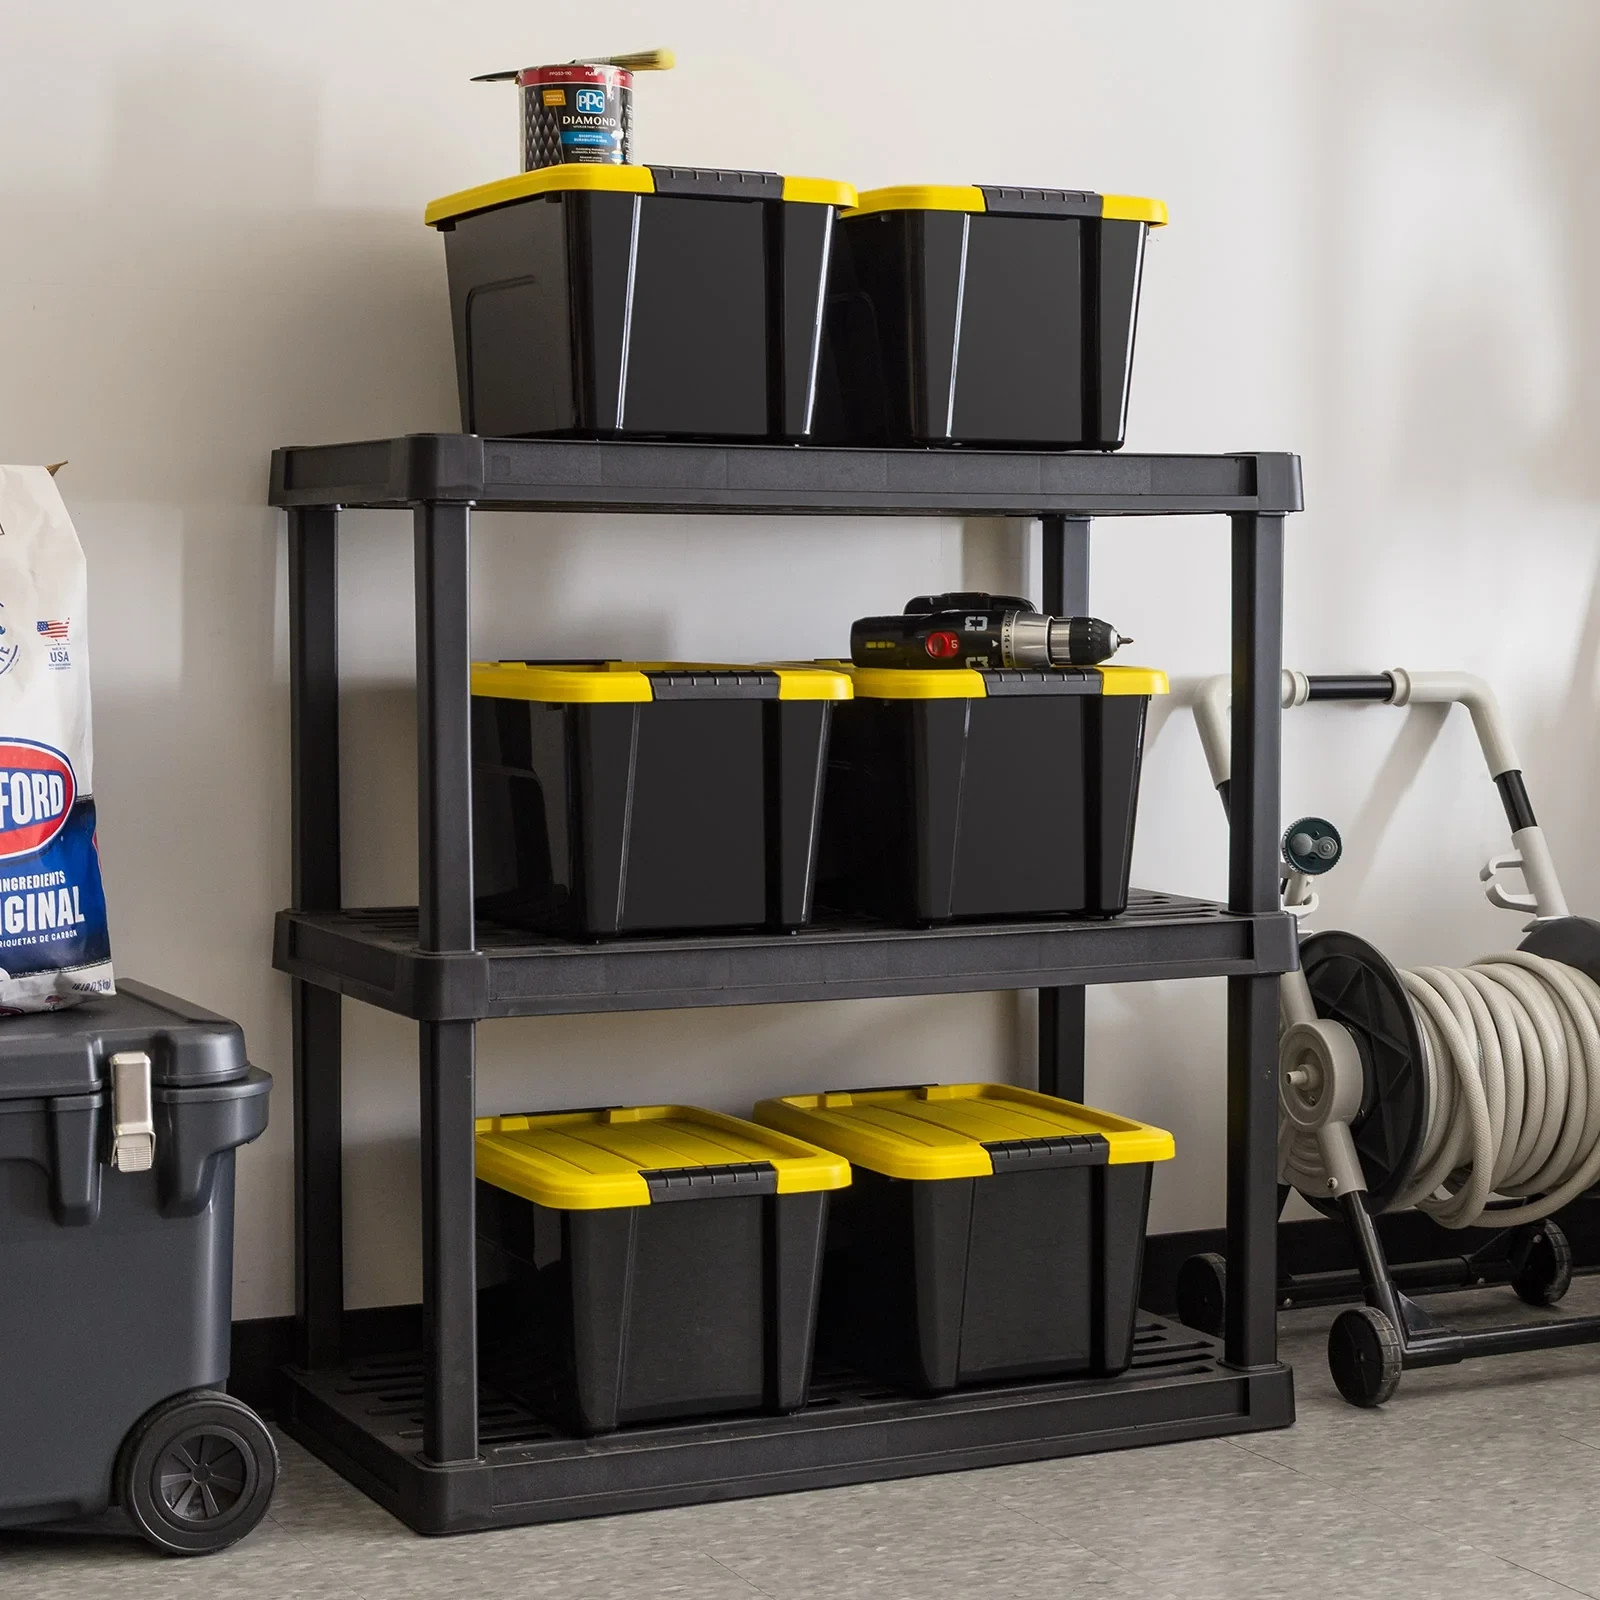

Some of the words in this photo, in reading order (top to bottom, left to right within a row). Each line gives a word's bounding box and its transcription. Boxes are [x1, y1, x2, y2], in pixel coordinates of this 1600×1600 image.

[579, 92, 603, 110] PPG
[562, 116, 616, 127] DIAMOND
[49, 651, 70, 663] USA
[0, 886, 86, 936] GINAL
[39, 934, 50, 943] DE
